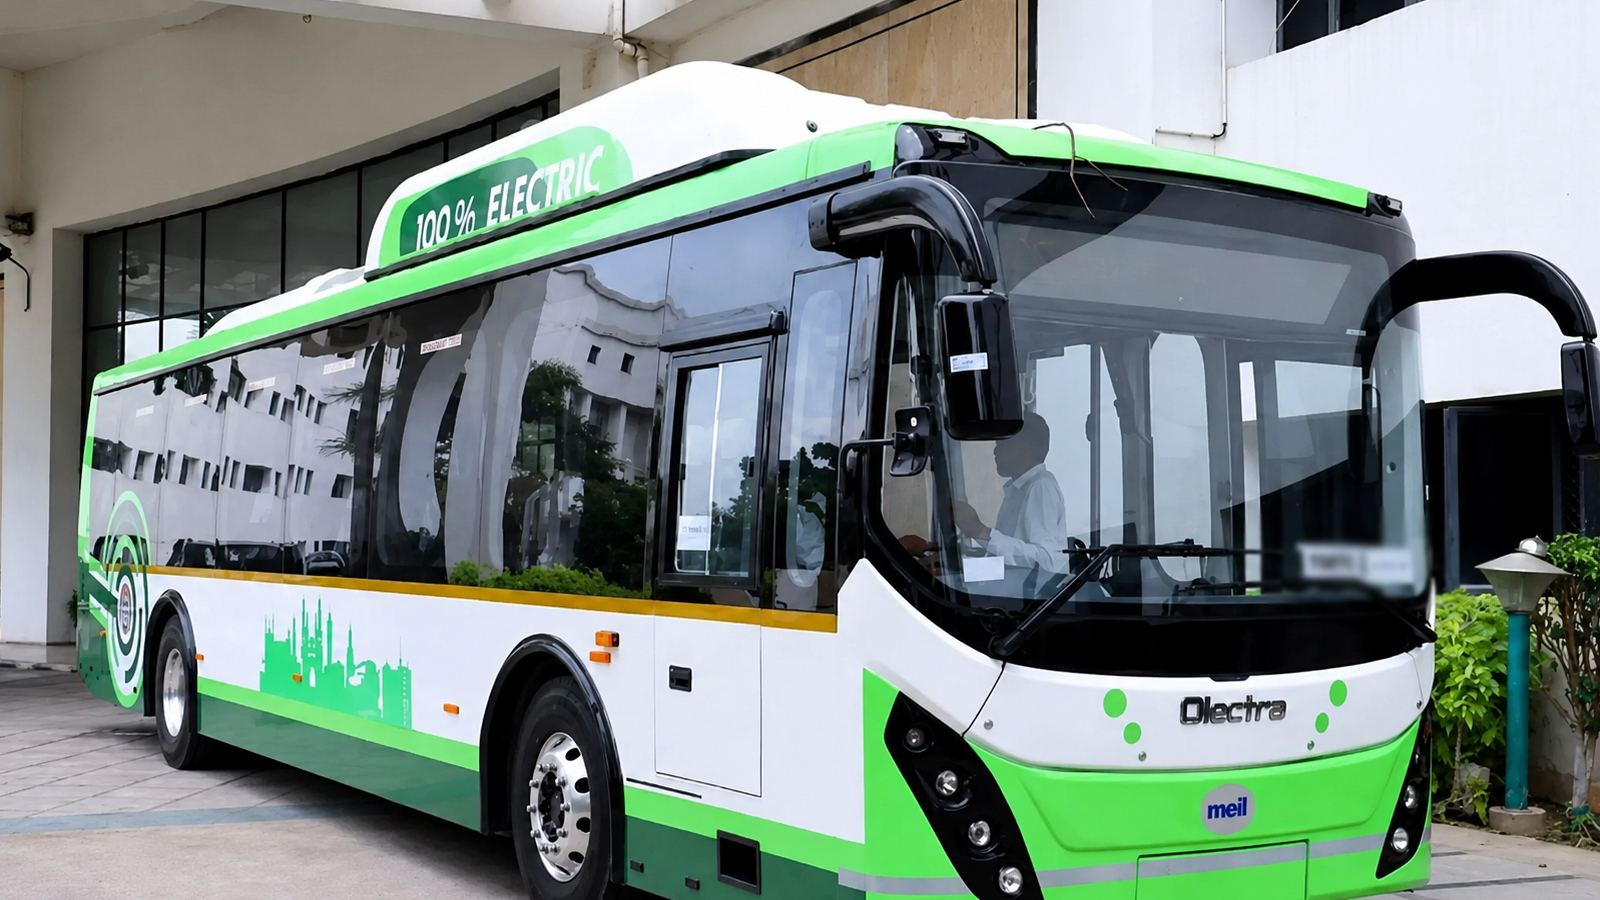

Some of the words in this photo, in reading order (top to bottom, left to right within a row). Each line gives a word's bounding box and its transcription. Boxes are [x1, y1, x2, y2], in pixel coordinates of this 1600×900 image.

[486, 145, 605, 229] ELECTRIC
[1180, 695, 1287, 725] Olectra
[1207, 797, 1248, 819] meil
